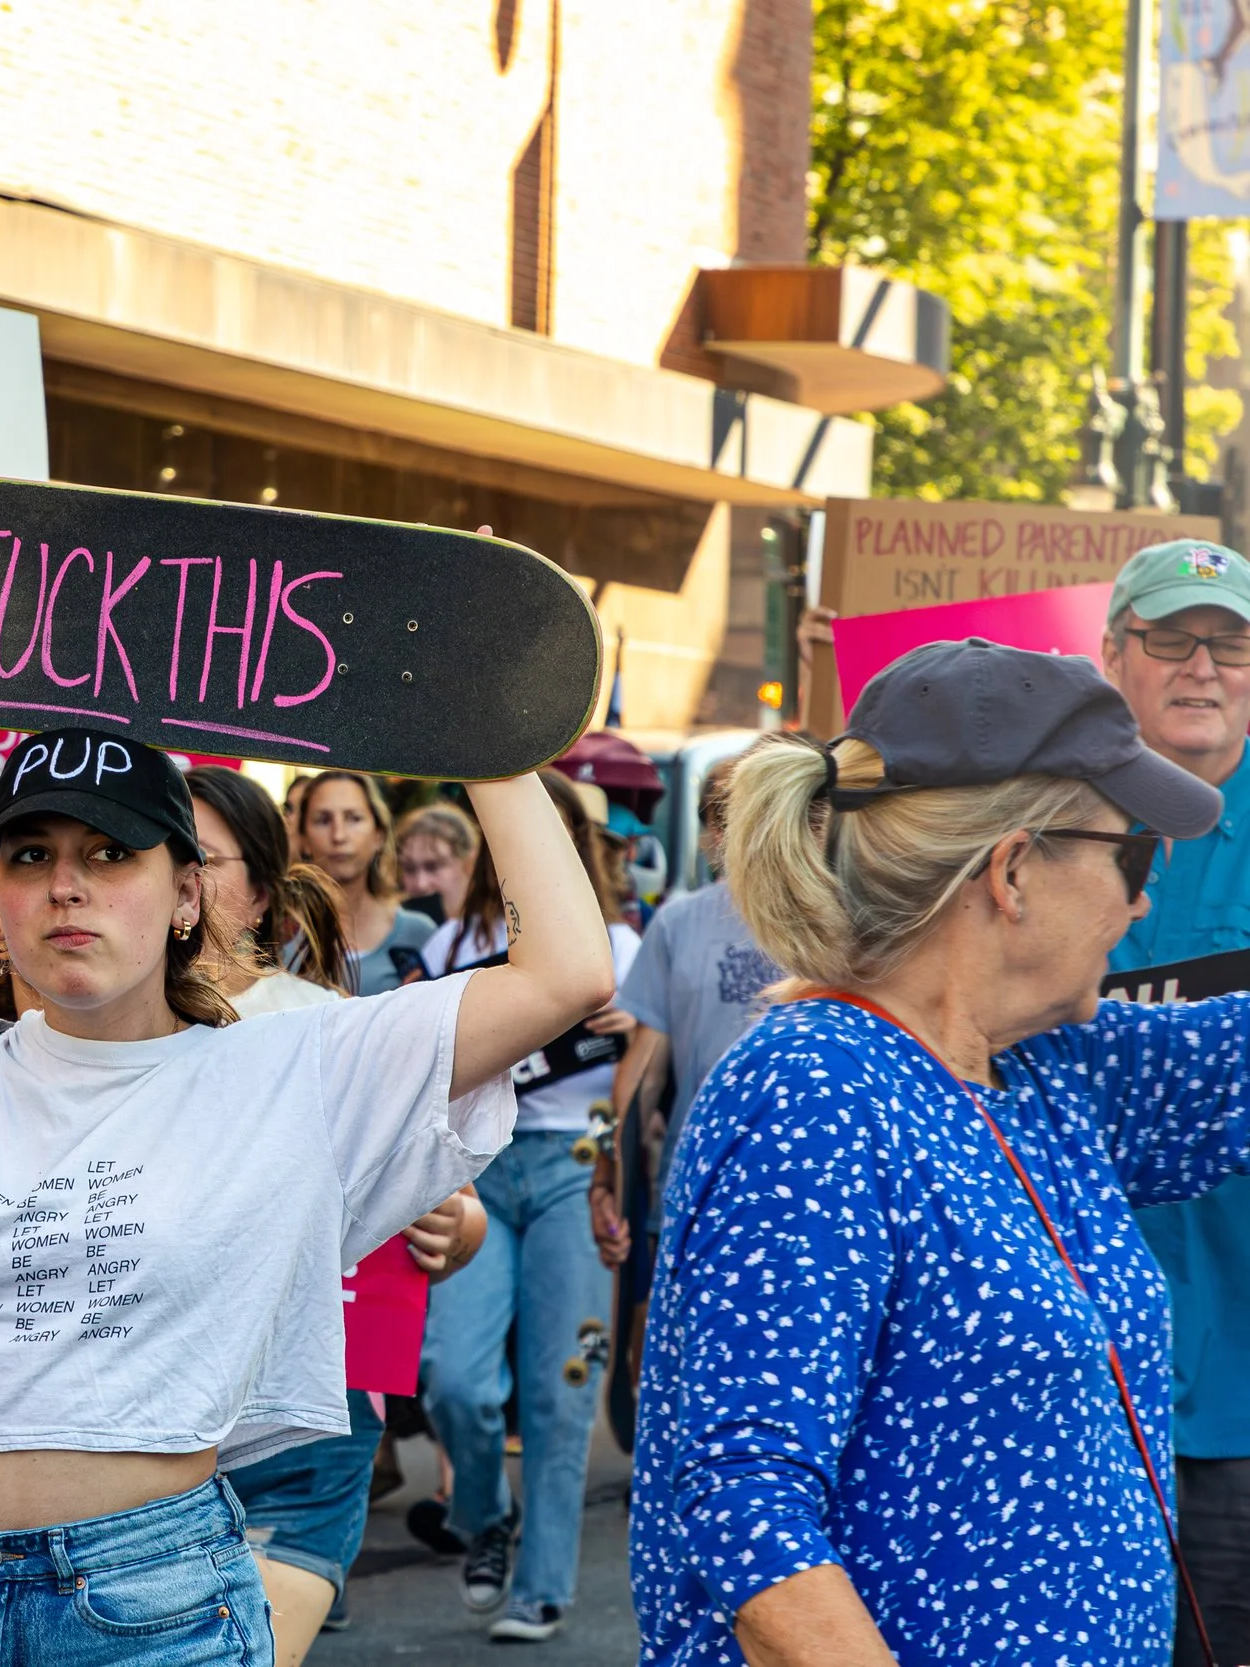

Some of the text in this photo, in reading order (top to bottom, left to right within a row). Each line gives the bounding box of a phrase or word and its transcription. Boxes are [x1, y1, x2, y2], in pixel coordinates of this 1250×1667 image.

[854, 516, 1006, 560] PLANNED
[160, 555, 344, 709] THIS
[13, 737, 133, 796] PUP
[87, 1160, 115, 1173] LET
[88, 1164, 143, 1189] WOMEN
[86, 1193, 138, 1213] ANGRY
[88, 1189, 106, 1203] BE
[13, 1210, 68, 1223] ANGRY
[84, 1211, 112, 1224] LET
[85, 1222, 144, 1240] WOMEN
[11, 1232, 69, 1251] WOMEN
[86, 1244, 106, 1258] BE
[12, 1254, 31, 1269] BE
[87, 1258, 140, 1276] ANGRY
[15, 1266, 67, 1282] ANGRY
[17, 1284, 44, 1297] LET
[89, 1279, 115, 1293] LET
[16, 1300, 73, 1313] WOMEN
[88, 1292, 143, 1309] WOMEN
[15, 1317, 34, 1330] BE
[81, 1312, 102, 1324] BE
[9, 1329, 59, 1342] ANGRY
[78, 1326, 133, 1341] ANGRY
